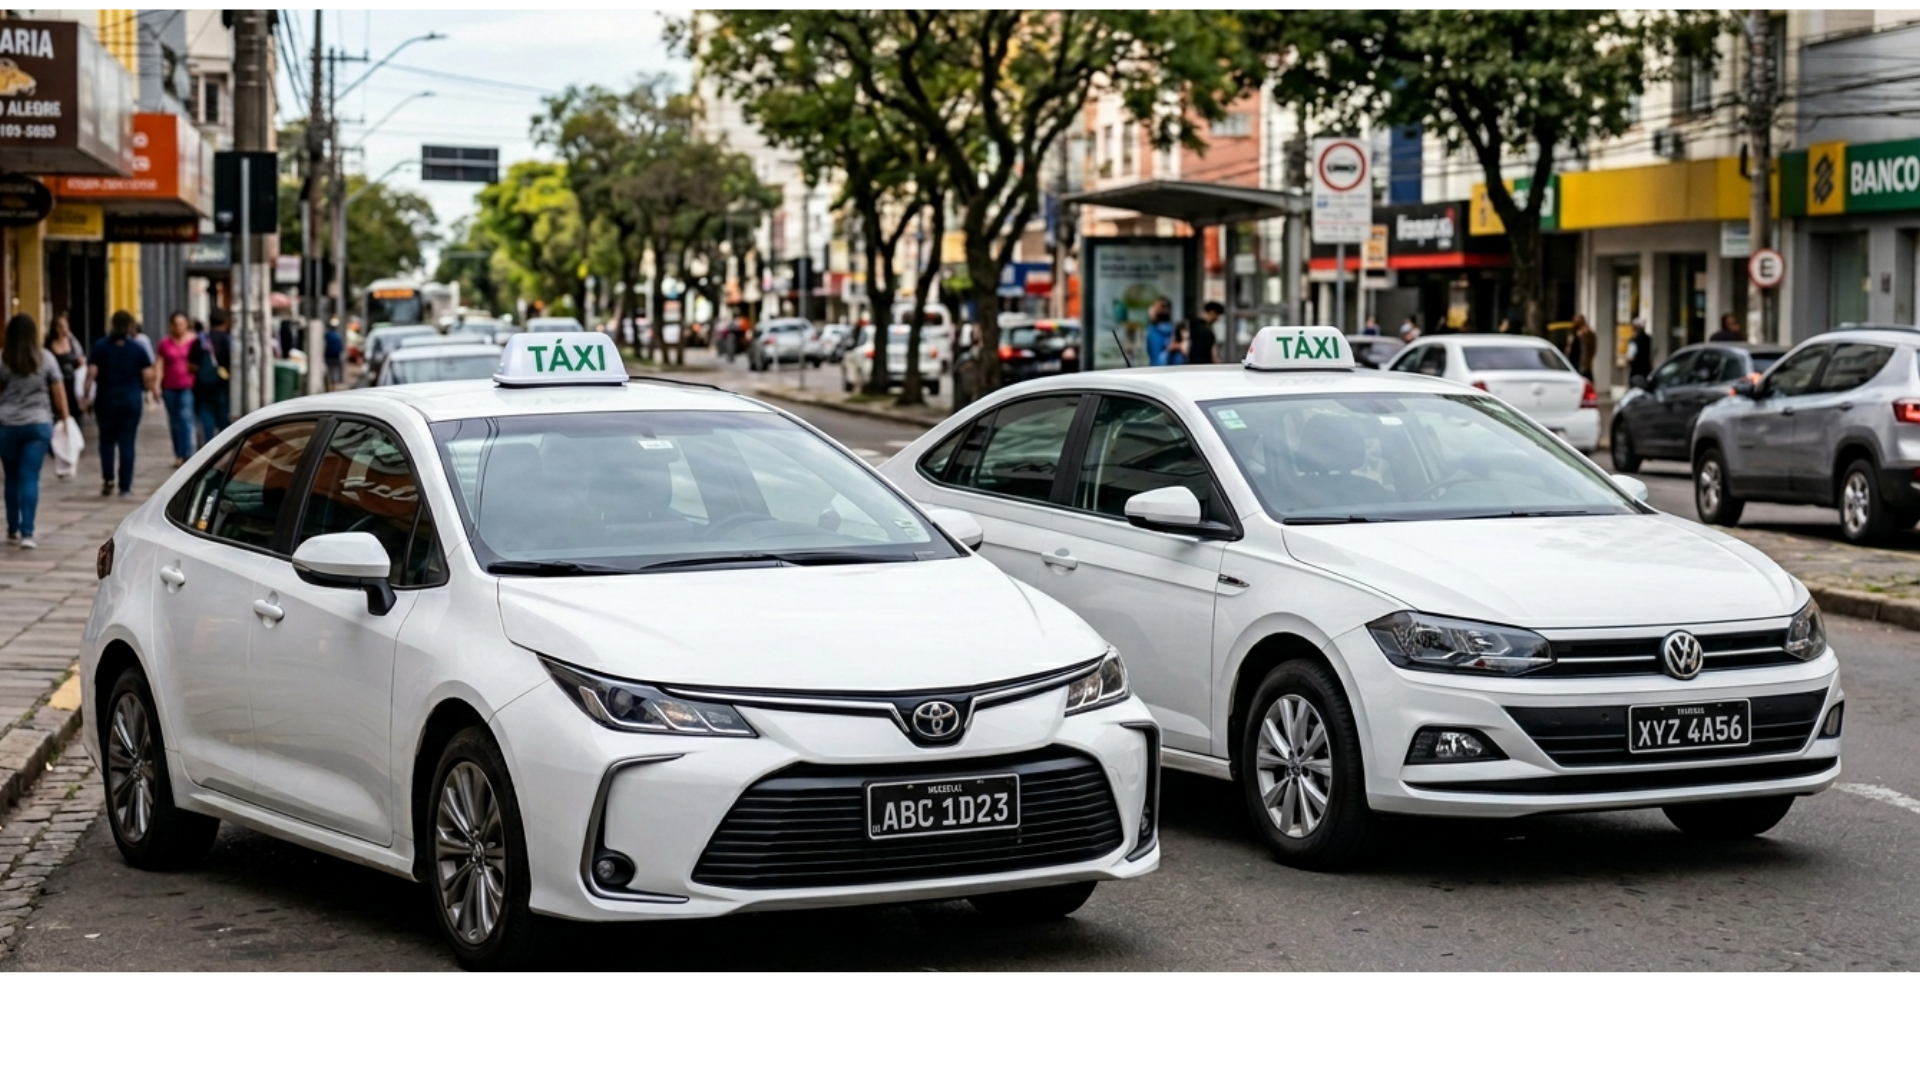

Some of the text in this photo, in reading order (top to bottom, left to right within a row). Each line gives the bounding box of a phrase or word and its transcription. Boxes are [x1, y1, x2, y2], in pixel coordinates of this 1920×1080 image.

[0, 28, 54, 59] ARIA
[1851, 155, 1920, 195] BANCO
[1760, 258, 1774, 278] E
[527, 338, 606, 372] TÁXI
[1276, 330, 1340, 360] TÁXI
[1638, 714, 1742, 747] XYZ 4A56
[882, 792, 1008, 831] ABC 1D23
